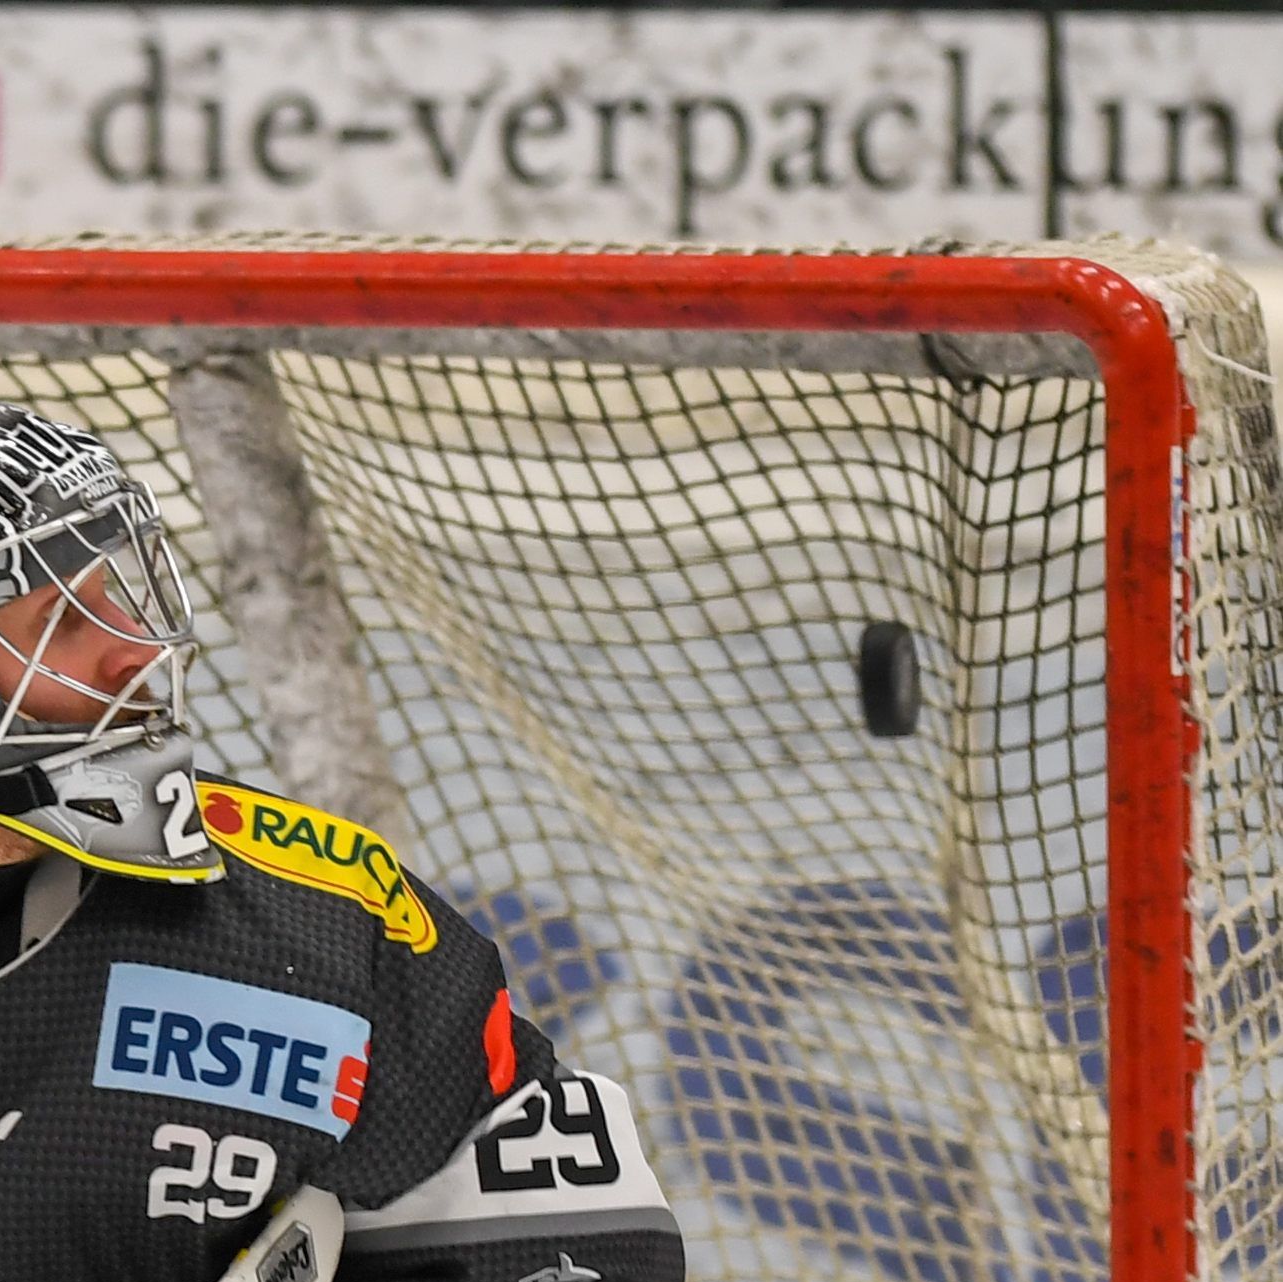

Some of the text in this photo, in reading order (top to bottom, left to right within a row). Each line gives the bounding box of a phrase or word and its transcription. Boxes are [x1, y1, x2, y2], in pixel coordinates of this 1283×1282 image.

[111, 1006, 328, 1110] ERSTE
[147, 1123, 278, 1225] 29
[475, 1077, 621, 1194] 29
